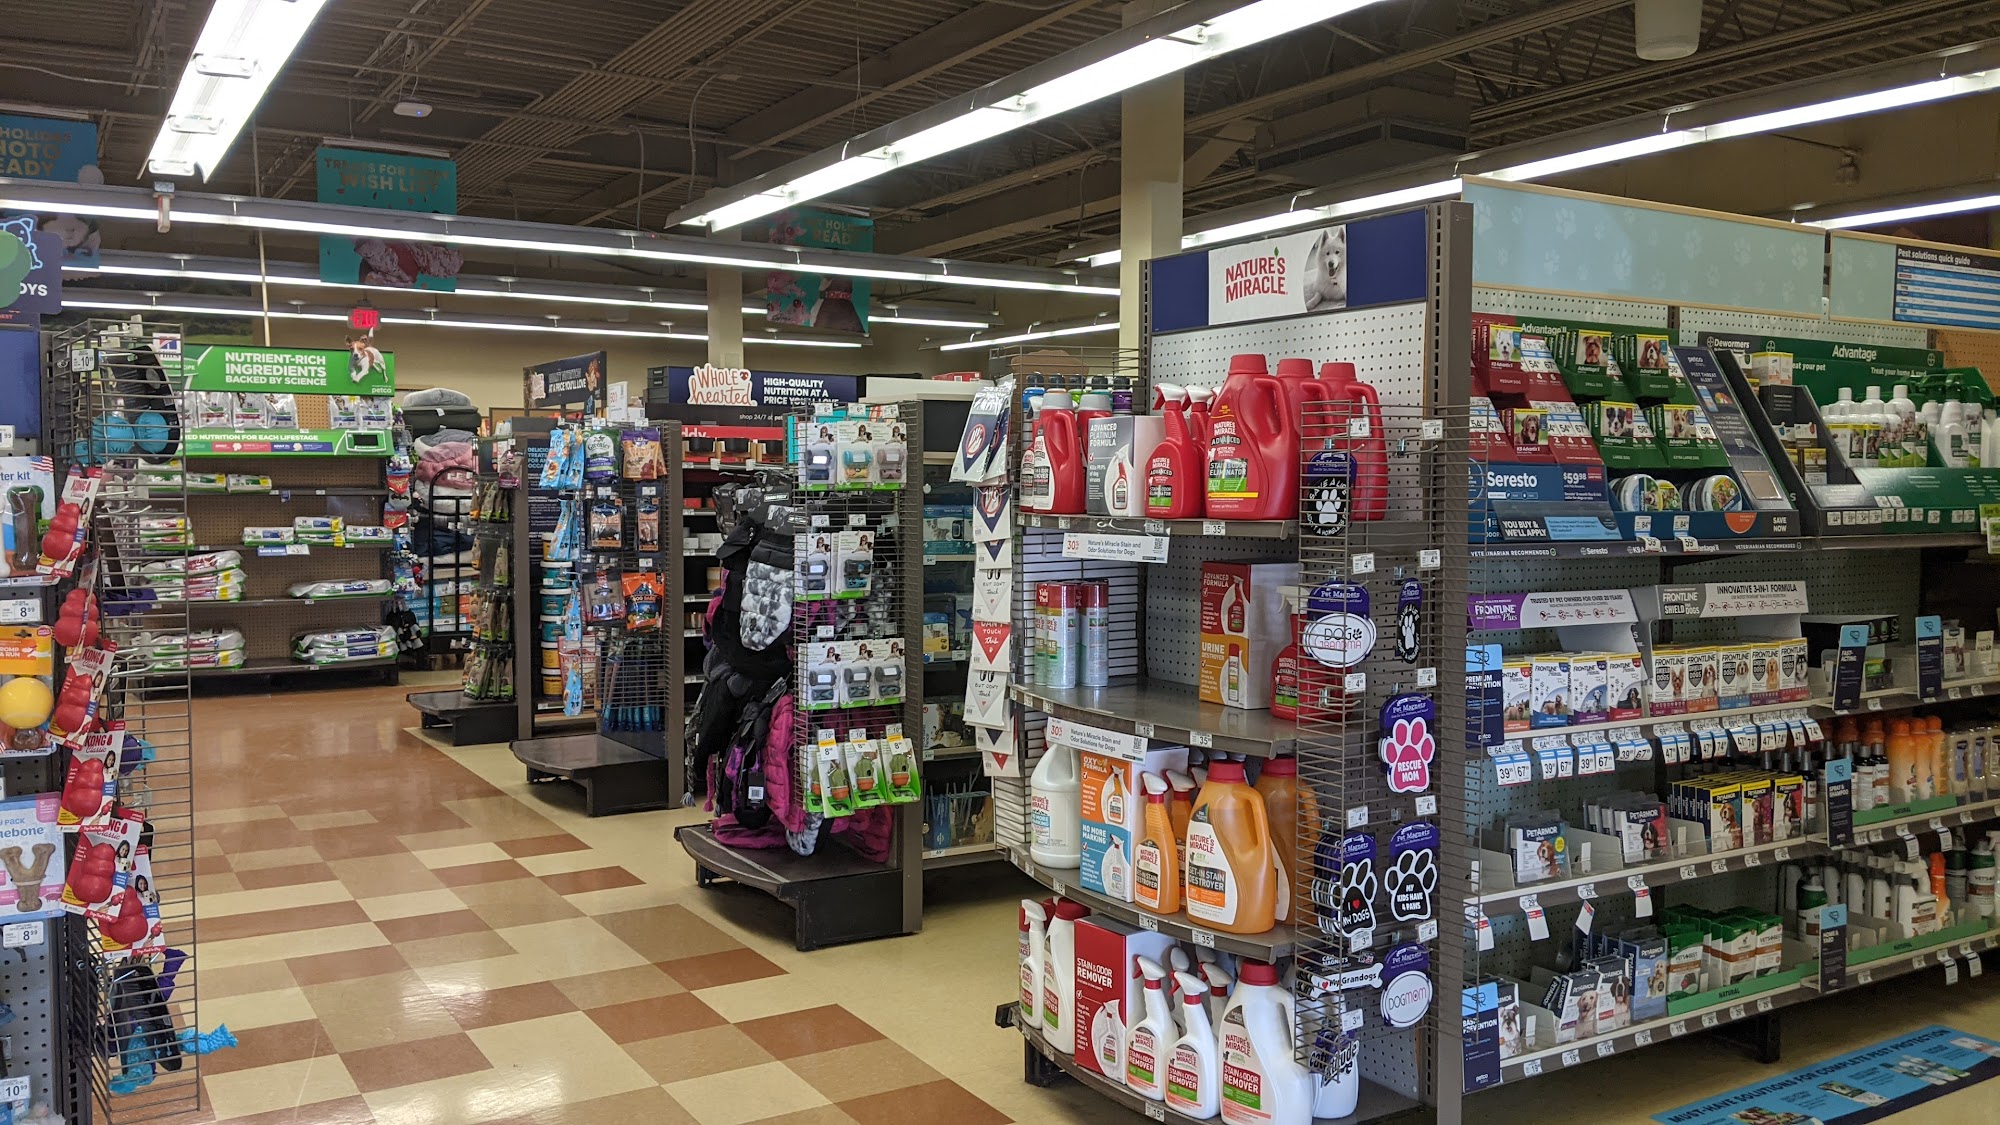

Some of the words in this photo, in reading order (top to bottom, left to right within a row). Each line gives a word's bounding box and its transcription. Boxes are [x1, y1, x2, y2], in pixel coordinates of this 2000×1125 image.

[0, 127, 71, 144] HOLID
[340, 172, 393, 190] WISH
[399, 179, 438, 193] LIST
[1898, 247, 1911, 258] Pest
[1911, 250, 1938, 262] solutions
[1938, 252, 1953, 264] quick
[1954, 254, 1971, 266] guide
[1225, 256, 1286, 285] NATURE'S
[1225, 275, 1287, 304] MIRACLE
[353, 309, 379, 328] EXIT
[1714, 338, 1750, 349] Dewormers
[1832, 343, 1878, 361] Advantage
[225, 351, 326, 366] NUTRIENT-RICH
[225, 363, 327, 378] INGREDIENTS
[225, 375, 267, 384] BACKED
[269, 376, 282, 385] BY
[284, 377, 327, 386] SCIENCE
[696, 368, 738, 389] WHOLE
[763, 377, 824, 388] HIGH-QUALITY
[371, 386, 392, 394] petco
[690, 378, 751, 406] hearted
[763, 387, 809, 397] NUTRITION
[810, 389, 821, 397] AT
[821, 390, 829, 398] A
[763, 396, 788, 405] PRICE
[1089, 422, 1117, 432] ADVANCED
[280, 434, 319, 442] LIFESTAGE
[1089, 431, 1117, 440] PLATINUM
[1089, 438, 1117, 448] FORMULA
[1487, 470, 1538, 489] Seresto
[1502, 520, 1519, 529] YOU
[1519, 520, 1533, 529] BUY
[1533, 520, 1539, 529] &
[1772, 516, 1787, 525] SAVE
[1504, 528, 1526, 537] WE'LL
[1525, 528, 1547, 537] APPLY
[1772, 525, 1788, 533] NOW
[1087, 539, 1104, 547] Nature's
[1104, 540, 1119, 548] Miracle
[1130, 541, 1141, 549] and
[1765, 542, 1796, 550] RECOMMENDED
[1097, 546, 1117, 554] Solutions
[1123, 548, 1136, 556] Dogs
[1470, 549, 1511, 557] VETEINARIAN
[1586, 546, 1609, 555] Seresto
[1203, 571, 1230, 582] ADVANCED
[1203, 579, 1229, 589] FORMULA
[1716, 585, 1753, 595] INNOVATIVE
[1753, 585, 1770, 594] 3-IN-1
[1770, 583, 1798, 593] FORMULA
[1563, 596, 1583, 604] OWNERS
[1608, 594, 1624, 602] YEARS
[1662, 591, 1699, 603] FRONTLINE
[1664, 604, 1686, 615] SHIELD
[1685, 606, 1700, 615] DOGS
[1502, 611, 1518, 622] Plus
[982, 628, 1002, 636] TOUCH
[1324, 627, 1352, 641] DOG
[1201, 641, 1225, 655] URINE
[1201, 650, 1225, 662] DESTROYER
[1654, 657, 1686, 667] FRONTLINE
[1687, 653, 1717, 665] FRONTLINE
[1721, 652, 1750, 663] FRONTLINE
[1840, 655, 1857, 663] ACTING
[1393, 704, 1403, 714] Pet
[1402, 701, 1426, 713] Magnets
[85, 734, 106, 747] KONG
[1070, 728, 1086, 738] Nature's
[1085, 731, 1099, 741] Miracle
[1100, 735, 1112, 744] Stain
[1111, 737, 1121, 745] and
[1083, 756, 1097, 766] OXY
[1397, 759, 1422, 772] RESCUE
[1401, 770, 1420, 783] MOM
[1828, 788, 1850, 797] SHAMPOO
[1629, 808, 1659, 820] PETARMOR
[1082, 823, 1090, 833] NO
[1091, 826, 1107, 838] MORE
[1396, 833, 1406, 843] Pet
[1406, 829, 1430, 840] Magnets
[1526, 826, 1558, 837] PETARMOR
[1082, 831, 1107, 845] MARKING
[1189, 833, 1215, 847] NATURE'S
[1189, 840, 1215, 855] MIRACLE
[1347, 842, 1369, 854] Magnets
[1188, 866, 1205, 879] SET-IN
[1205, 870, 1225, 883] STAIN
[1188, 875, 1225, 892] DESTROYER
[1405, 883, 1415, 892] MY
[1396, 892, 1409, 903] KIDS
[1408, 891, 1424, 902] HAVE
[1405, 901, 1422, 911] PAWS
[1351, 908, 1371, 922] DOGS
[1076, 957, 1093, 971] STAIN
[1096, 964, 1113, 978] ODOR
[1076, 966, 1113, 989] REMOVER
[1342, 972, 1377, 985] Grandogs
[1718, 986, 1741, 999] NATURAL
[1225, 1040, 1252, 1058] MIRACLE
[1223, 1064, 1240, 1078] STAIN
[1242, 1070, 1260, 1084] ODOR
[1476, 1073, 1489, 1083] petco
[1667, 1096, 1737, 1124] MUST-HAVE
[1734, 1076, 1798, 1102] SOLUTIONS
[1797, 1071, 1816, 1085] FOR
[1815, 1053, 1866, 1080] COMPLETE
[1866, 1045, 1890, 1062] PEST
[1889, 1027, 1952, 1055] PROTECTION
[1168, 1075, 1198, 1091] REMOVER
[1223, 1074, 1260, 1095] REMOVER
